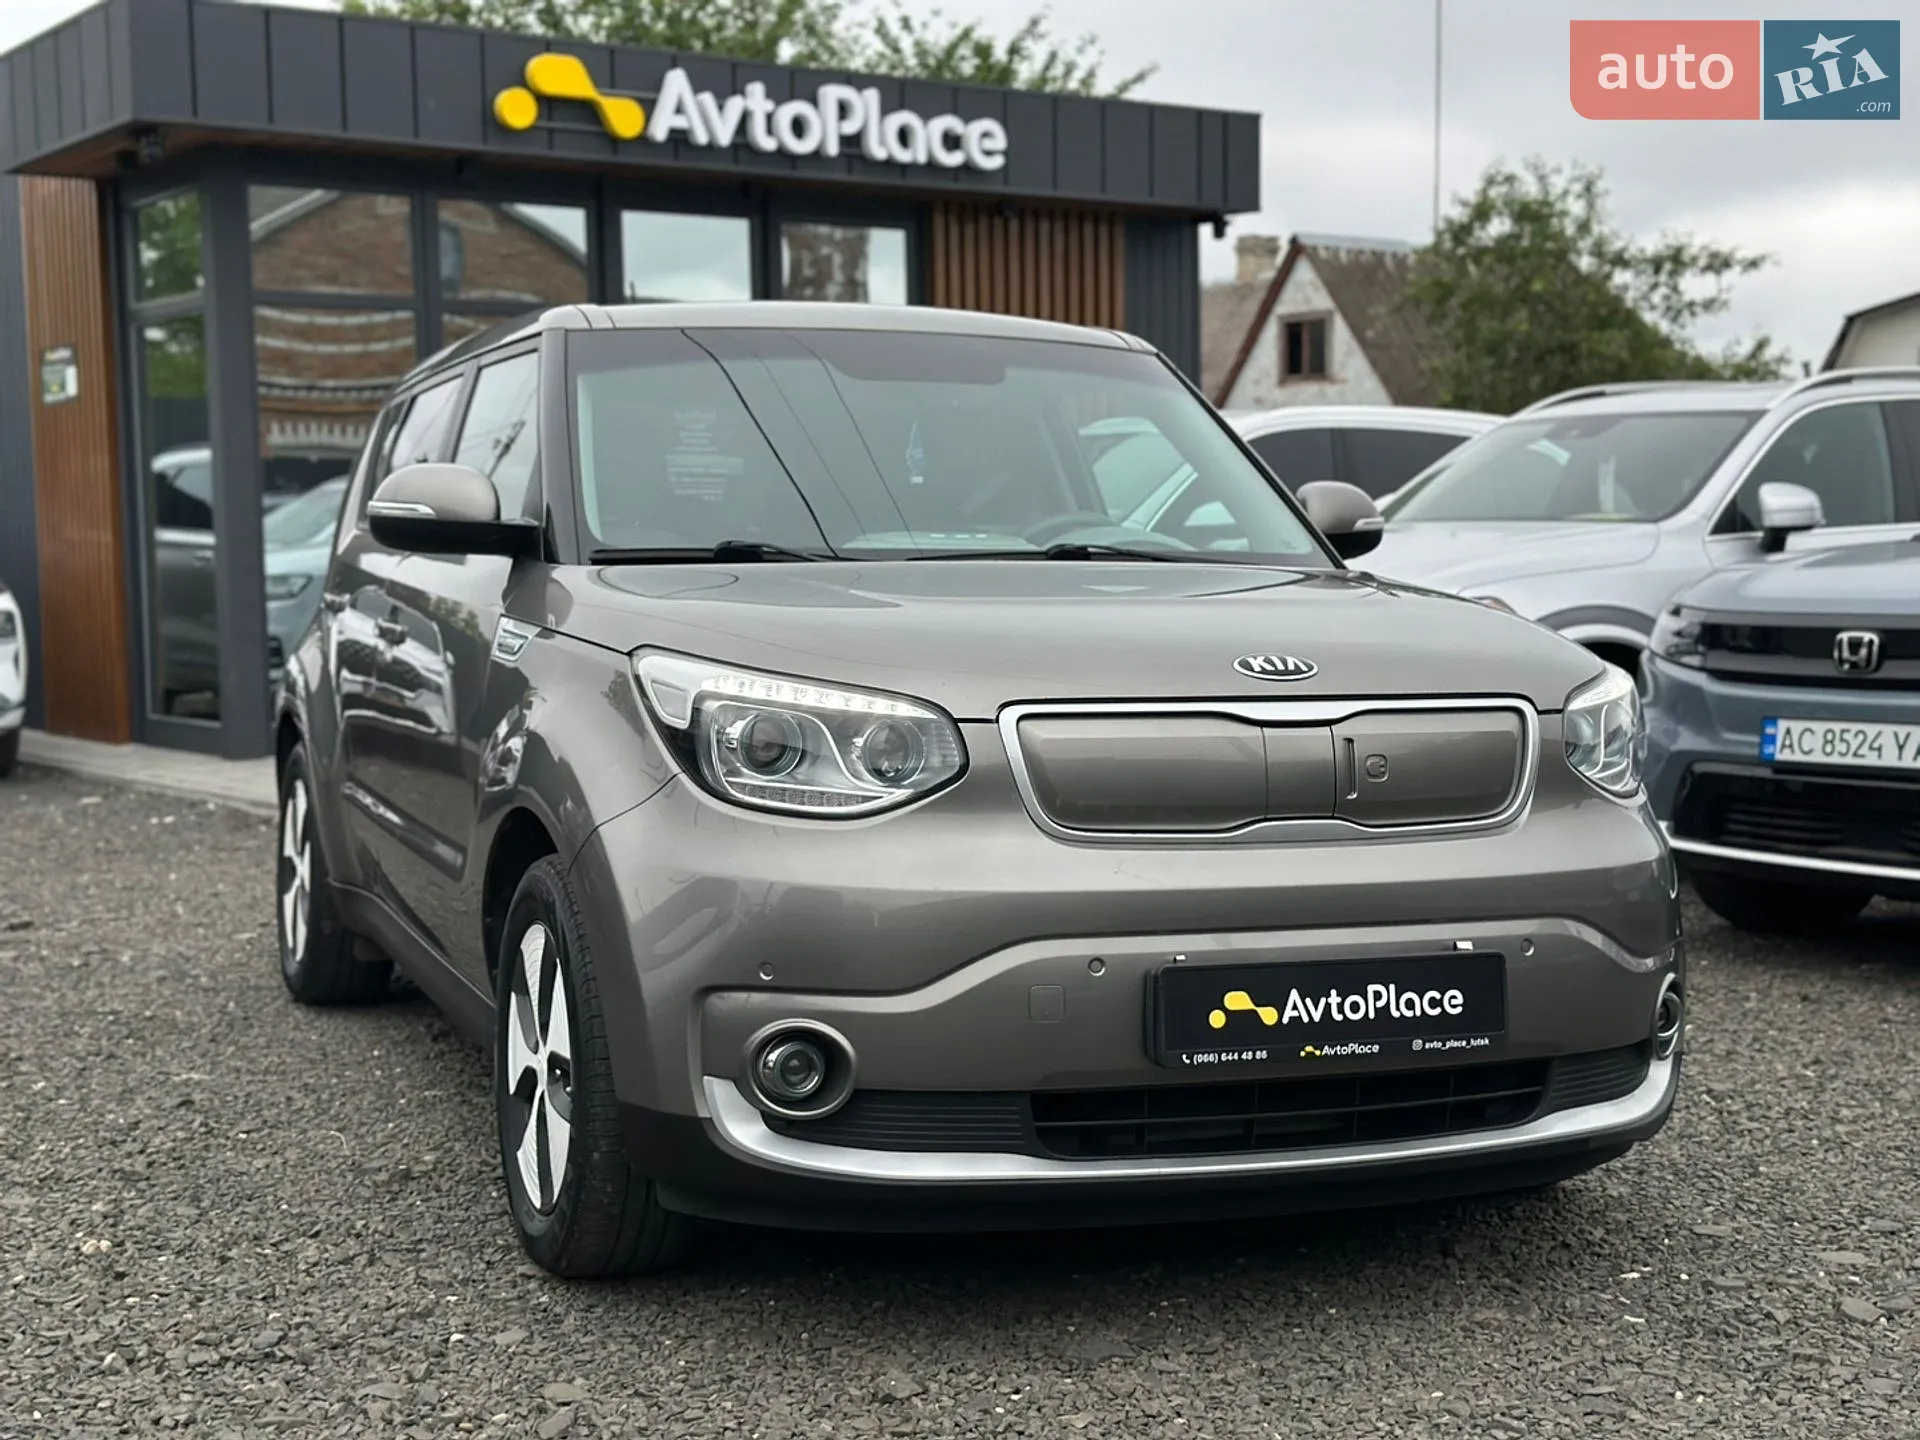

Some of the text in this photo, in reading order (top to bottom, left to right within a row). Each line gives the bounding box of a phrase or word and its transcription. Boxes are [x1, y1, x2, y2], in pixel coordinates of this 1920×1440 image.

[645, 66, 1009, 172] AvtoPlace
[1245, 654, 1309, 673] KIA
[1779, 726, 1816, 756] AC
[1821, 727, 1883, 761] 8524
[1281, 983, 1464, 1025] AvtoPlace
[1321, 1042, 1380, 1057] AvtoPlace
